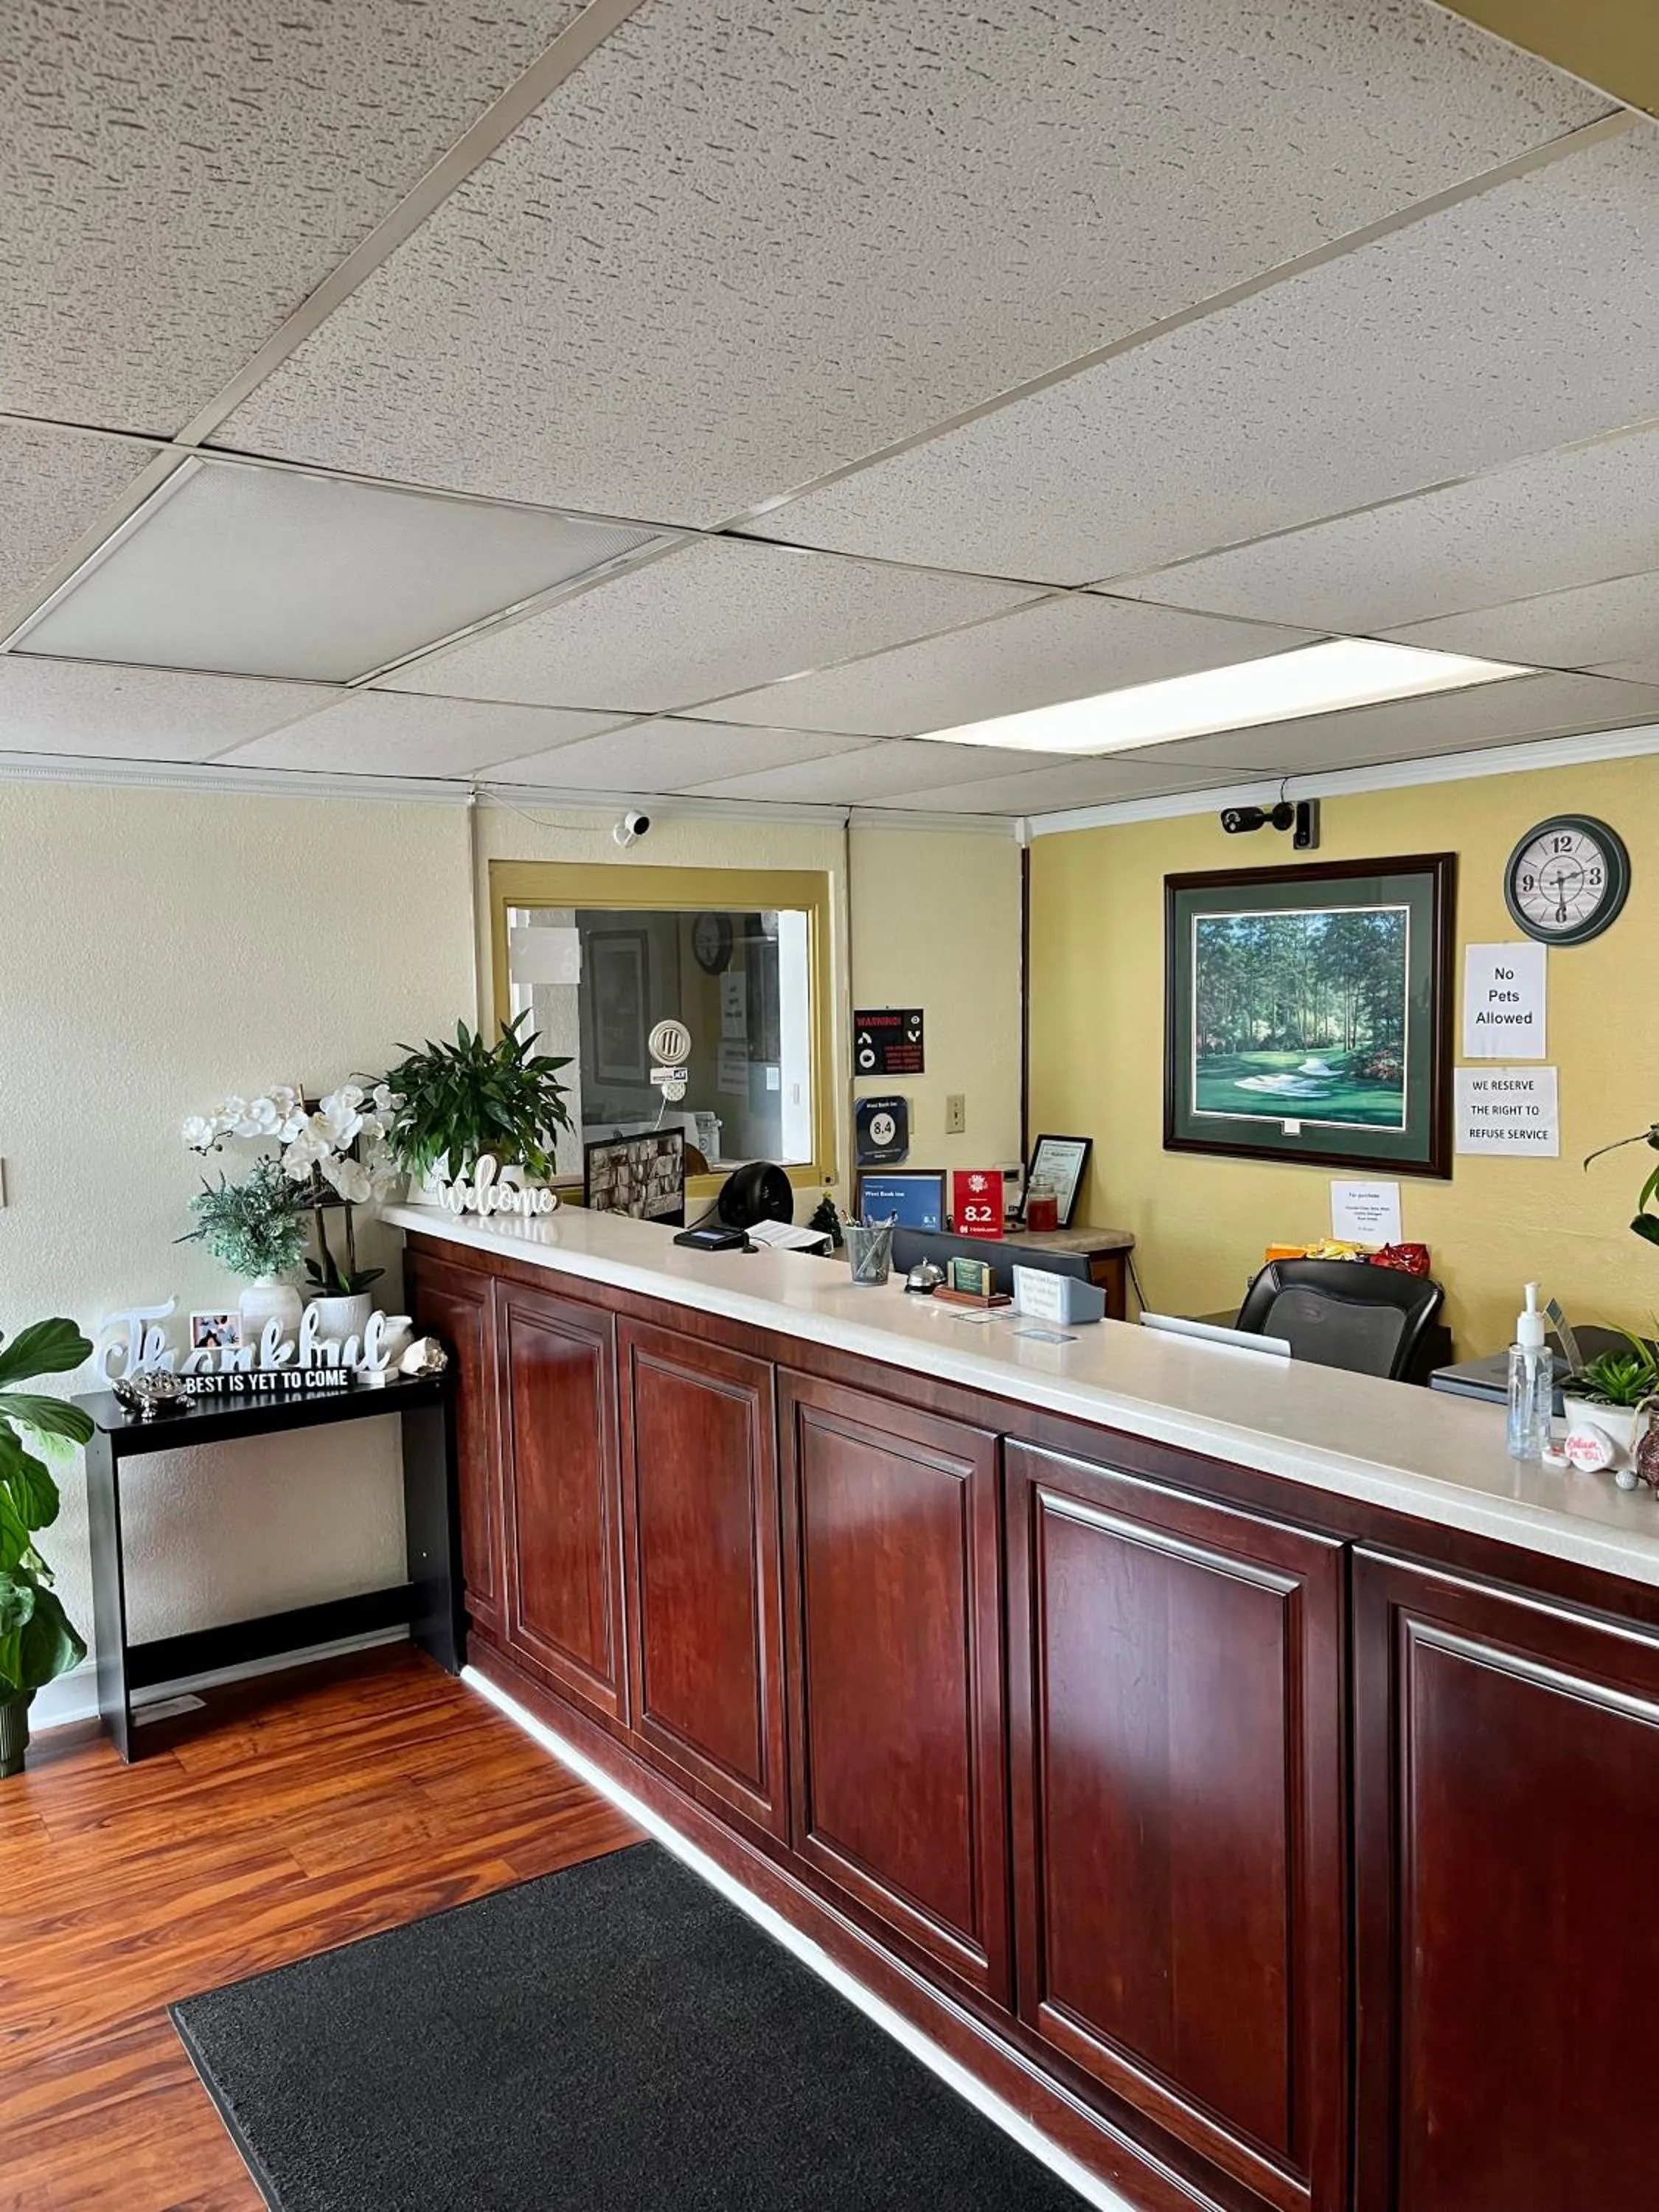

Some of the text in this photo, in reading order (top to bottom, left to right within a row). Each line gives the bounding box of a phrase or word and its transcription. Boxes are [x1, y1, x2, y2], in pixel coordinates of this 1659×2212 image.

[1551, 835, 1573, 853] 12
[1523, 874, 1534, 892] 9
[1589, 866, 1602, 886] 3
[1555, 906, 1568, 923] 6
[1494, 967, 1514, 980] No
[1488, 990, 1520, 1002] Pets
[1475, 1011, 1533, 1024] Allowed
[1472, 1080, 1534, 1091] WE RESERVE
[1471, 1105, 1540, 1116] THE RIGHT TO
[874, 1121, 891, 1134] 8.4
[1469, 1129, 1549, 1140] REFUSE SERVICE
[437, 1153, 558, 1217] welcome
[964, 1206, 992, 1222] 8.2
[186, 1369, 349, 1394] BEST IS YET TO COME
